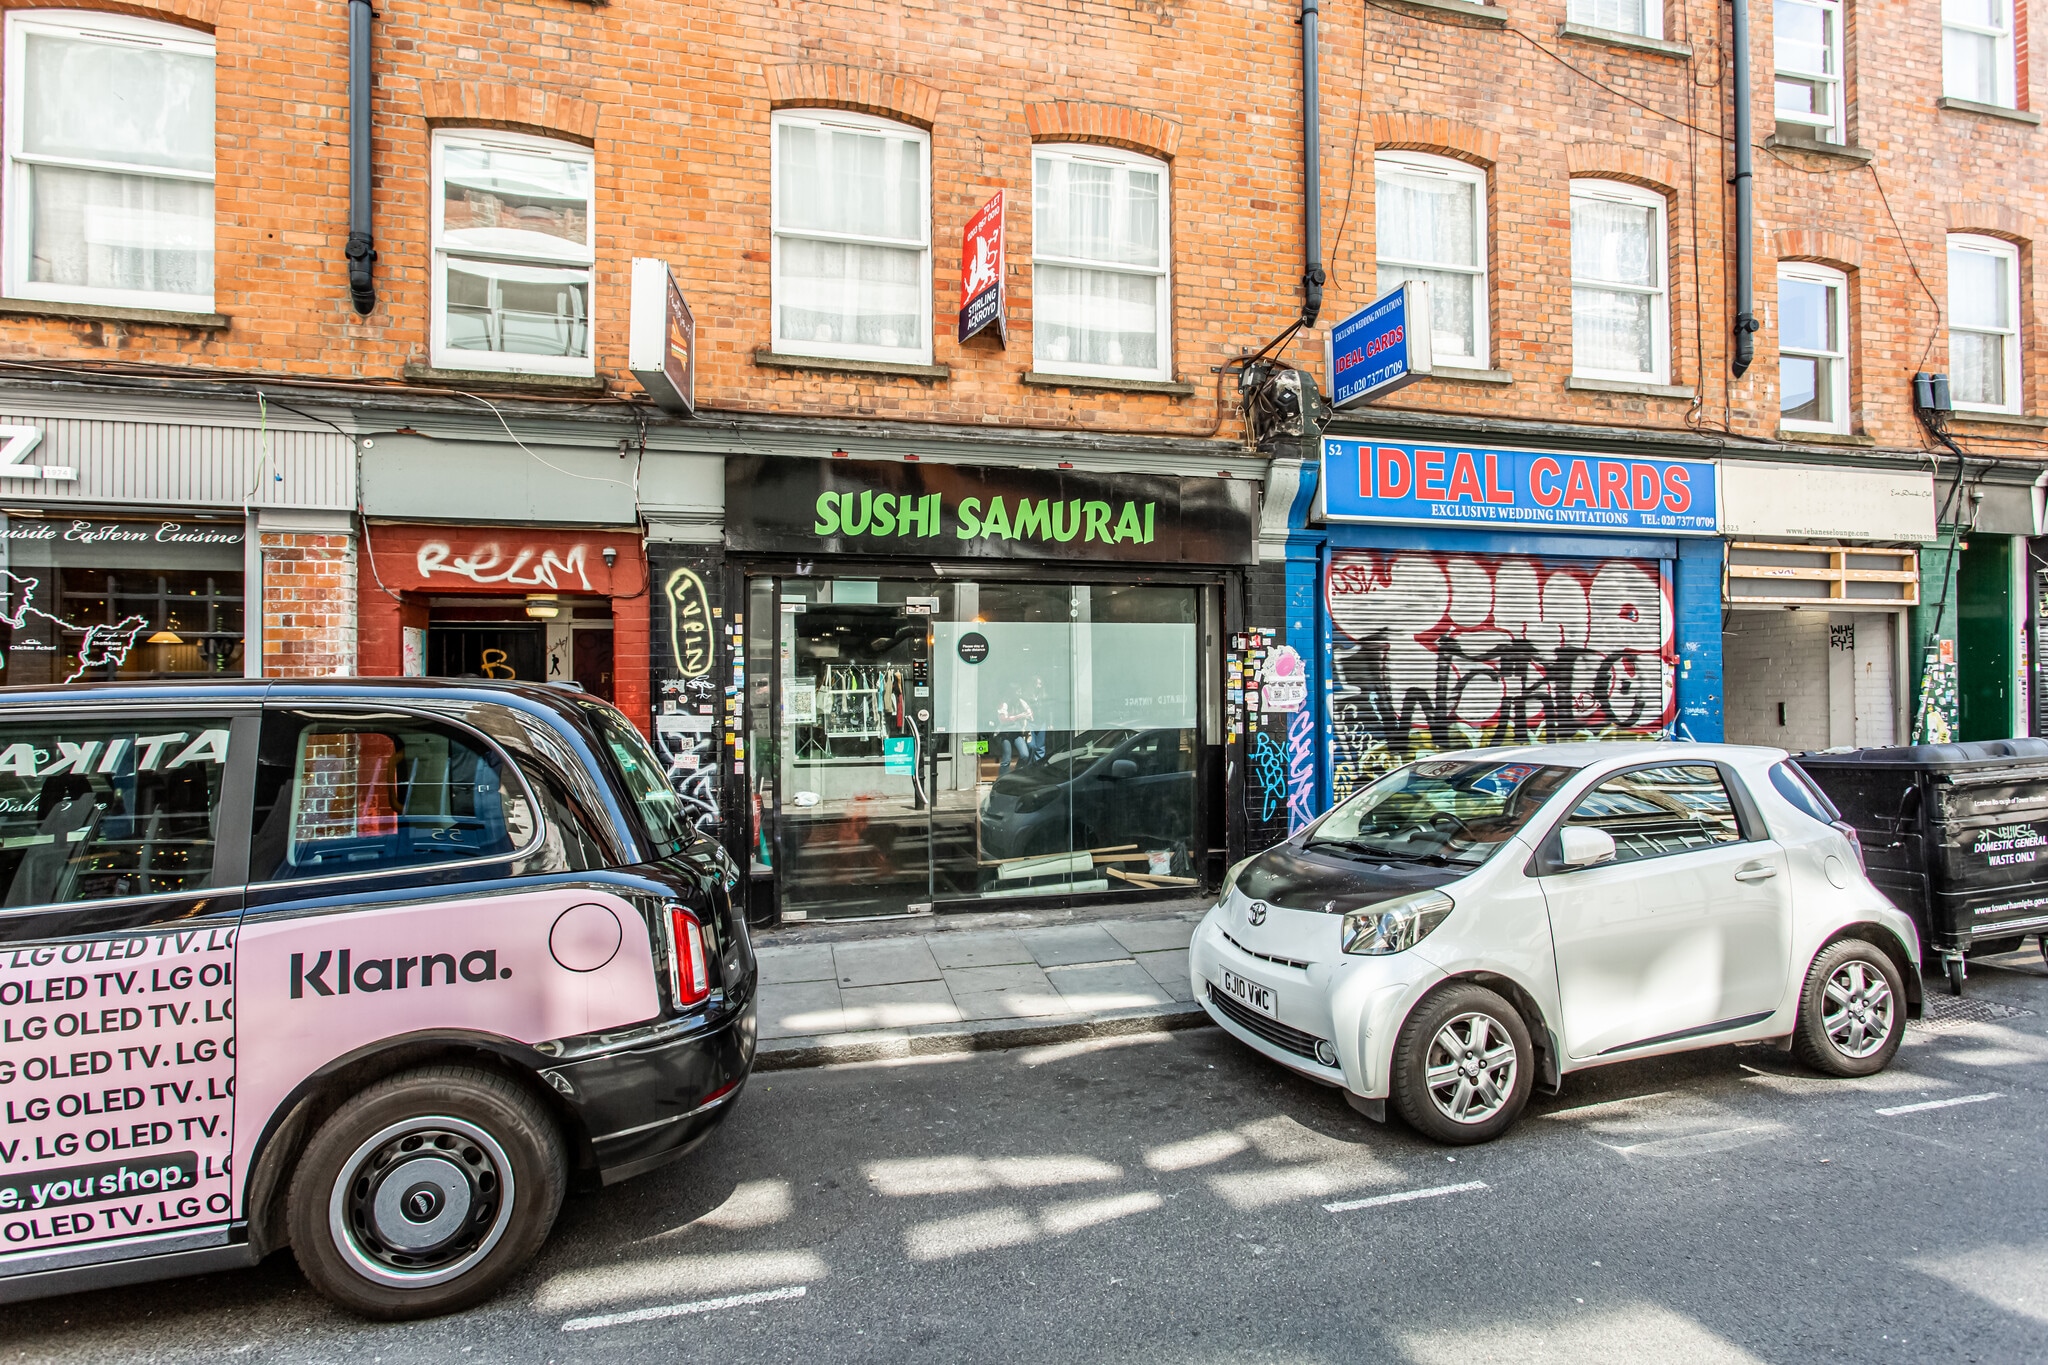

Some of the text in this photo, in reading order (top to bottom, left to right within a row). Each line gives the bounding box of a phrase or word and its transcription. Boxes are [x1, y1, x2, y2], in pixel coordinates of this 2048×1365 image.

[984, 194, 1000, 215] TO LET
[968, 288, 996, 317] STIRLING
[968, 302, 995, 331] ACKROYD
[1335, 296, 1403, 342] EXCLUSIVE WEDDING INVITATIONS
[1335, 325, 1404, 374] IDEAL CARDS
[1338, 360, 1403, 400] TEL: 020 7377 0709
[1328, 443, 1343, 456] 52
[1358, 446, 1692, 513] IDEAL CARDS
[63, 520, 148, 542] Eastern
[155, 521, 245, 544] Cuisine
[814, 489, 1155, 545] SUSHI SAMURAI
[1431, 503, 1715, 529] EXCLUSIVE WEDDING INVITATIONS TEL: 020 7377 0709
[1785, 527, 1870, 538] www.lebaneselounge.com
[1974, 835, 2048, 853] DOMESTIC GENERAL
[1989, 851, 2035, 866] WASTE ONLY
[10, 945, 57, 969] LG
[61, 937, 148, 963] OLED
[0, 975, 88, 1006] OLED
[94, 970, 145, 996] TV.
[152, 965, 193, 992] LG
[290, 948, 513, 1000] Klarna.
[1225, 972, 1270, 1010] GJ10 VWC
[4, 1015, 48, 1043] LG
[54, 1007, 143, 1037] OLED
[148, 1001, 199, 1027] TV.
[23, 1050, 112, 1081] OLED
[118, 1044, 170, 1071] TV.
[176, 1038, 217, 1065] LG
[6, 1097, 51, 1124] LG
[56, 1086, 146, 1118] OLED
[151, 1079, 202, 1106] TV.
[36, 1131, 80, 1160] LG
[85, 1121, 173, 1152] OLED
[178, 1114, 228, 1141] TV.
[31, 1176, 95, 1208] you
[100, 1165, 191, 1196] shop.
[4, 1211, 95, 1243] OLED
[99, 1203, 154, 1228] TV.
[158, 1196, 201, 1221] LG
